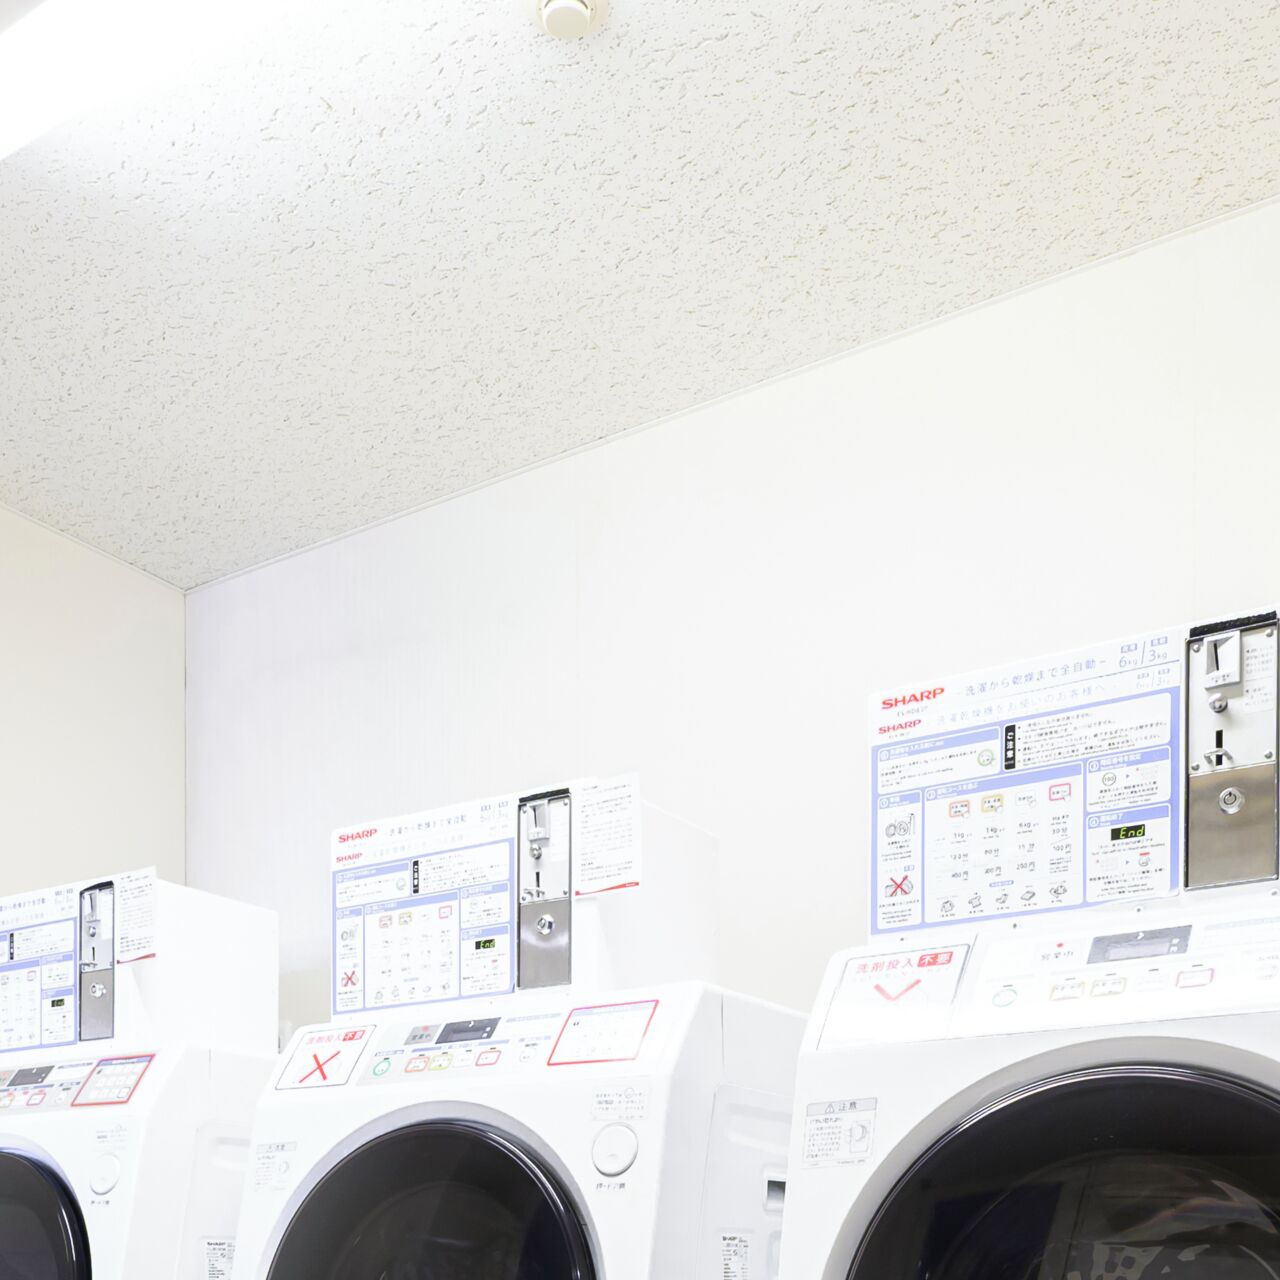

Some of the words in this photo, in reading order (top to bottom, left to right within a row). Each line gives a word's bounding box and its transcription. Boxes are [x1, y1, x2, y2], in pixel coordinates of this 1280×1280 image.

[881, 687, 945, 710] SHARP
[878, 719, 922, 735] SHARP
[338, 827, 378, 844] SHARP
[1119, 826, 1144, 839] End
[336, 850, 363, 864] SHARP
